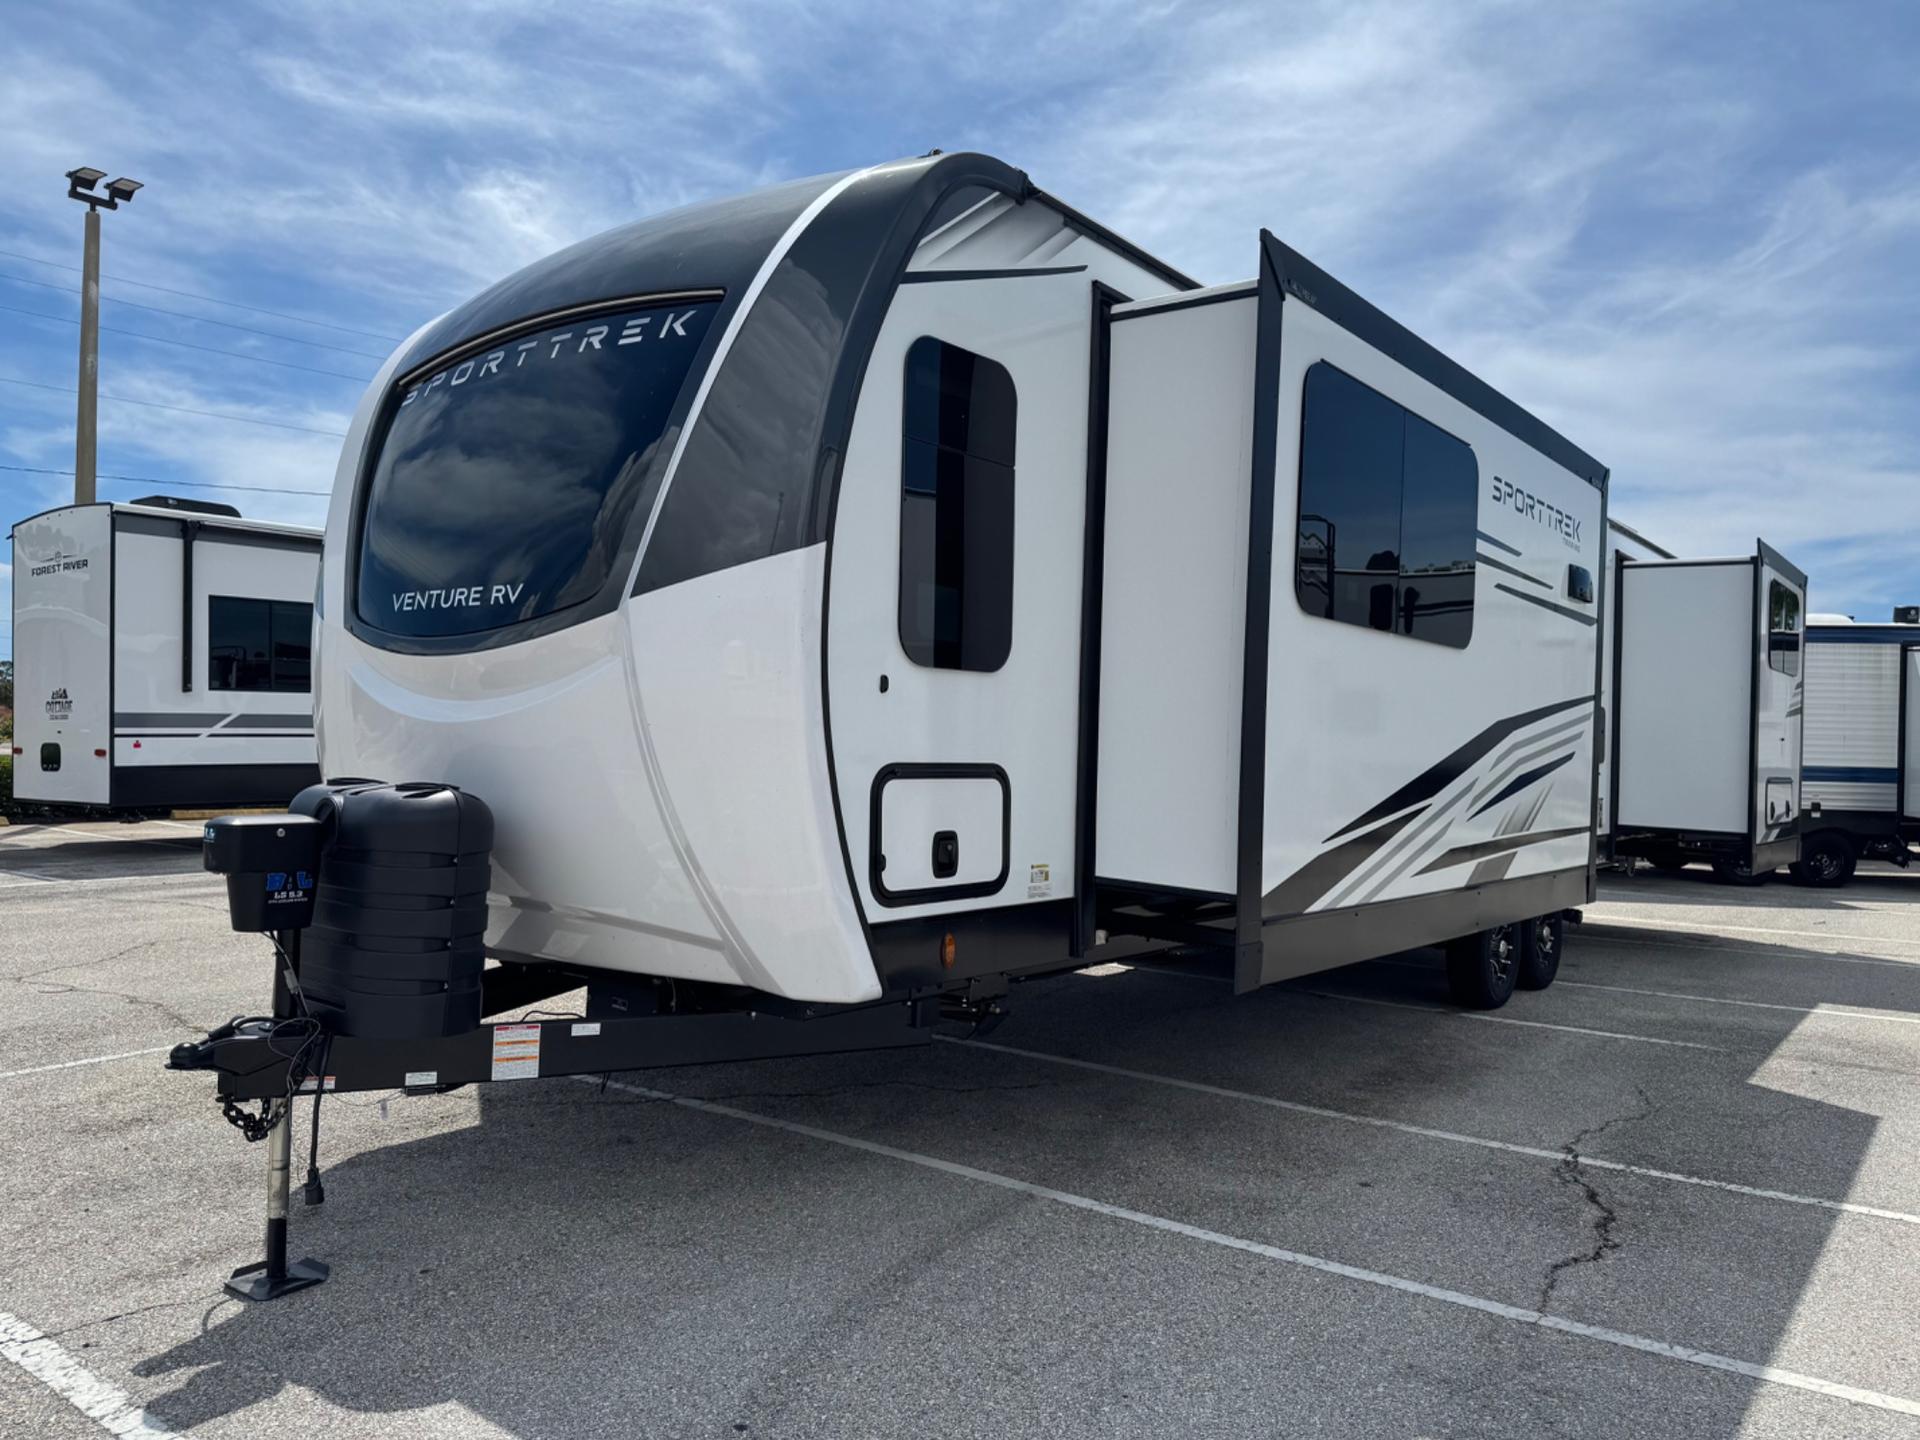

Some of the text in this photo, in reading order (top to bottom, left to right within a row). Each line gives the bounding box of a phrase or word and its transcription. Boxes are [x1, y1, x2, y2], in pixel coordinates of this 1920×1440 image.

[401, 310, 697, 407] SPORTTREK
[1492, 475, 1581, 543] SPORTTREK
[31, 559, 88, 577] FOREST RIVER
[392, 583, 524, 612] VENTURE RV
